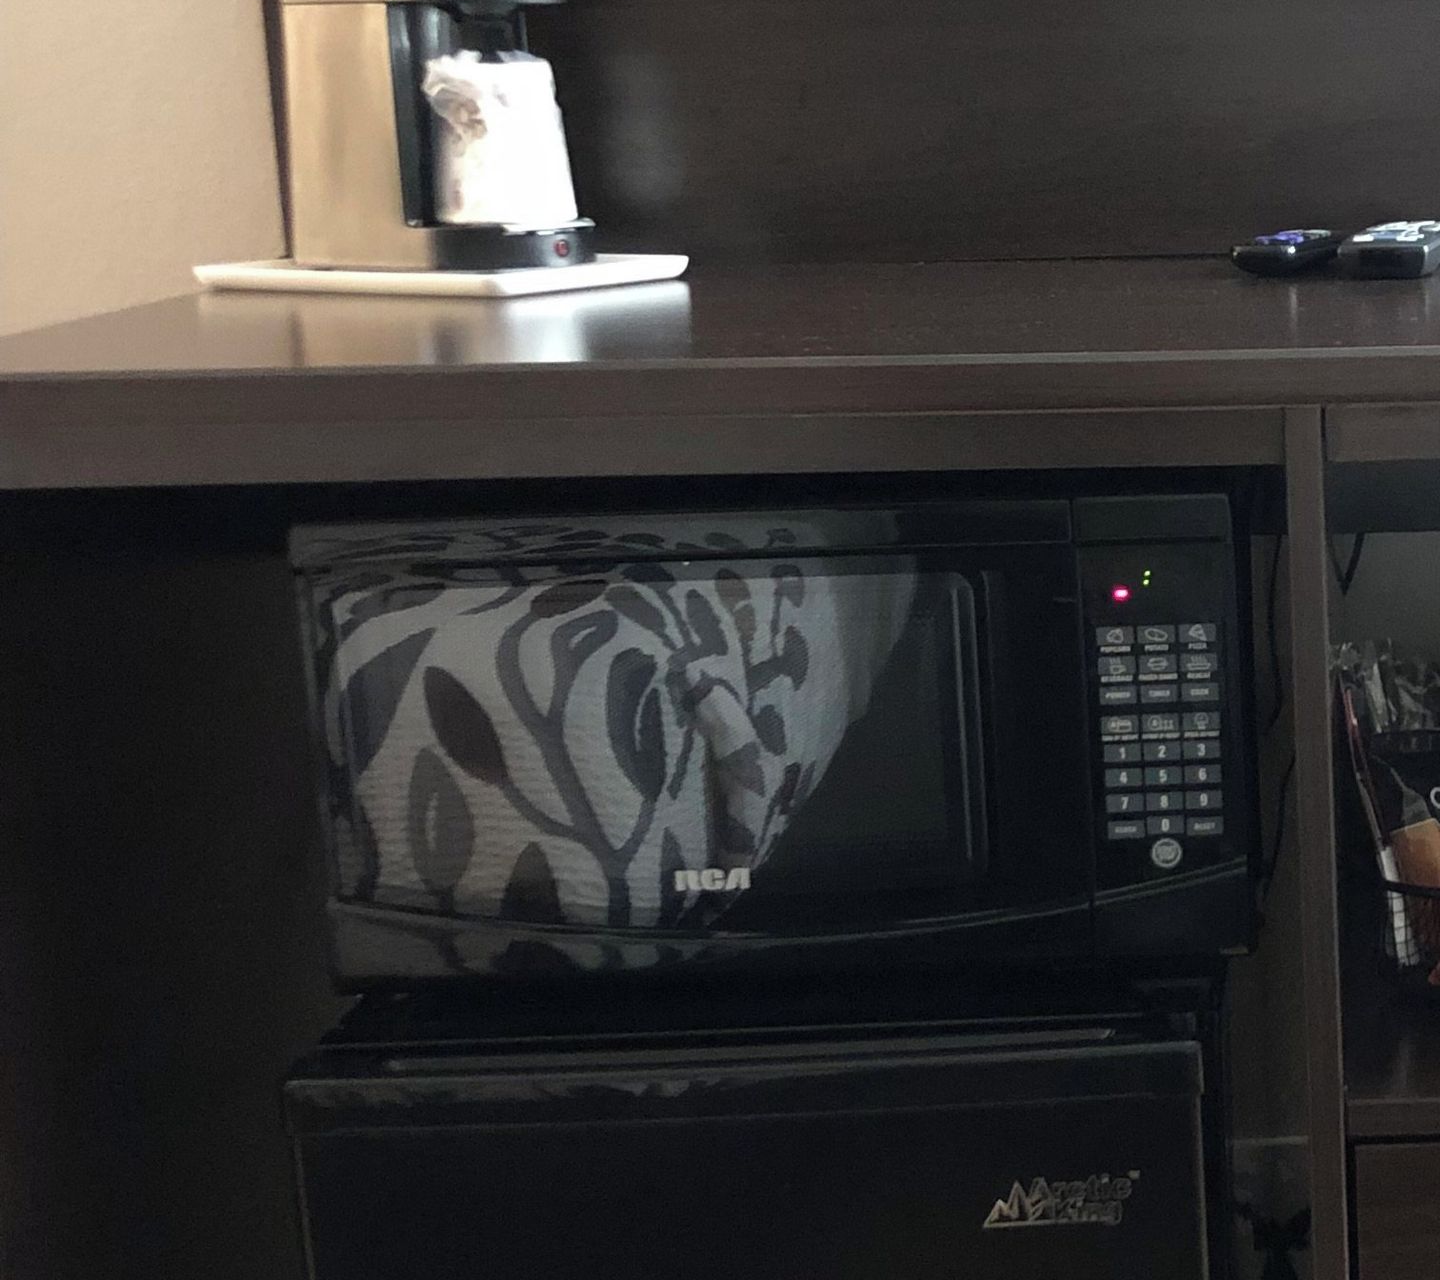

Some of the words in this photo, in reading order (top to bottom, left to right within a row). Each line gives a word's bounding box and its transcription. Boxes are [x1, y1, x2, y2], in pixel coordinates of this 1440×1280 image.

[1119, 746, 1126, 759] 1
[1158, 744, 1166, 758] 2
[1197, 743, 1206, 756] 3
[1120, 771, 1128, 784] 4
[1159, 768, 1168, 782] 5
[1198, 767, 1207, 781] 6
[1121, 796, 1129, 810] 7
[1160, 794, 1169, 808] 8
[1200, 792, 1209, 806] 9
[1161, 818, 1170, 832] 0
[674, 867, 752, 892] RCA
